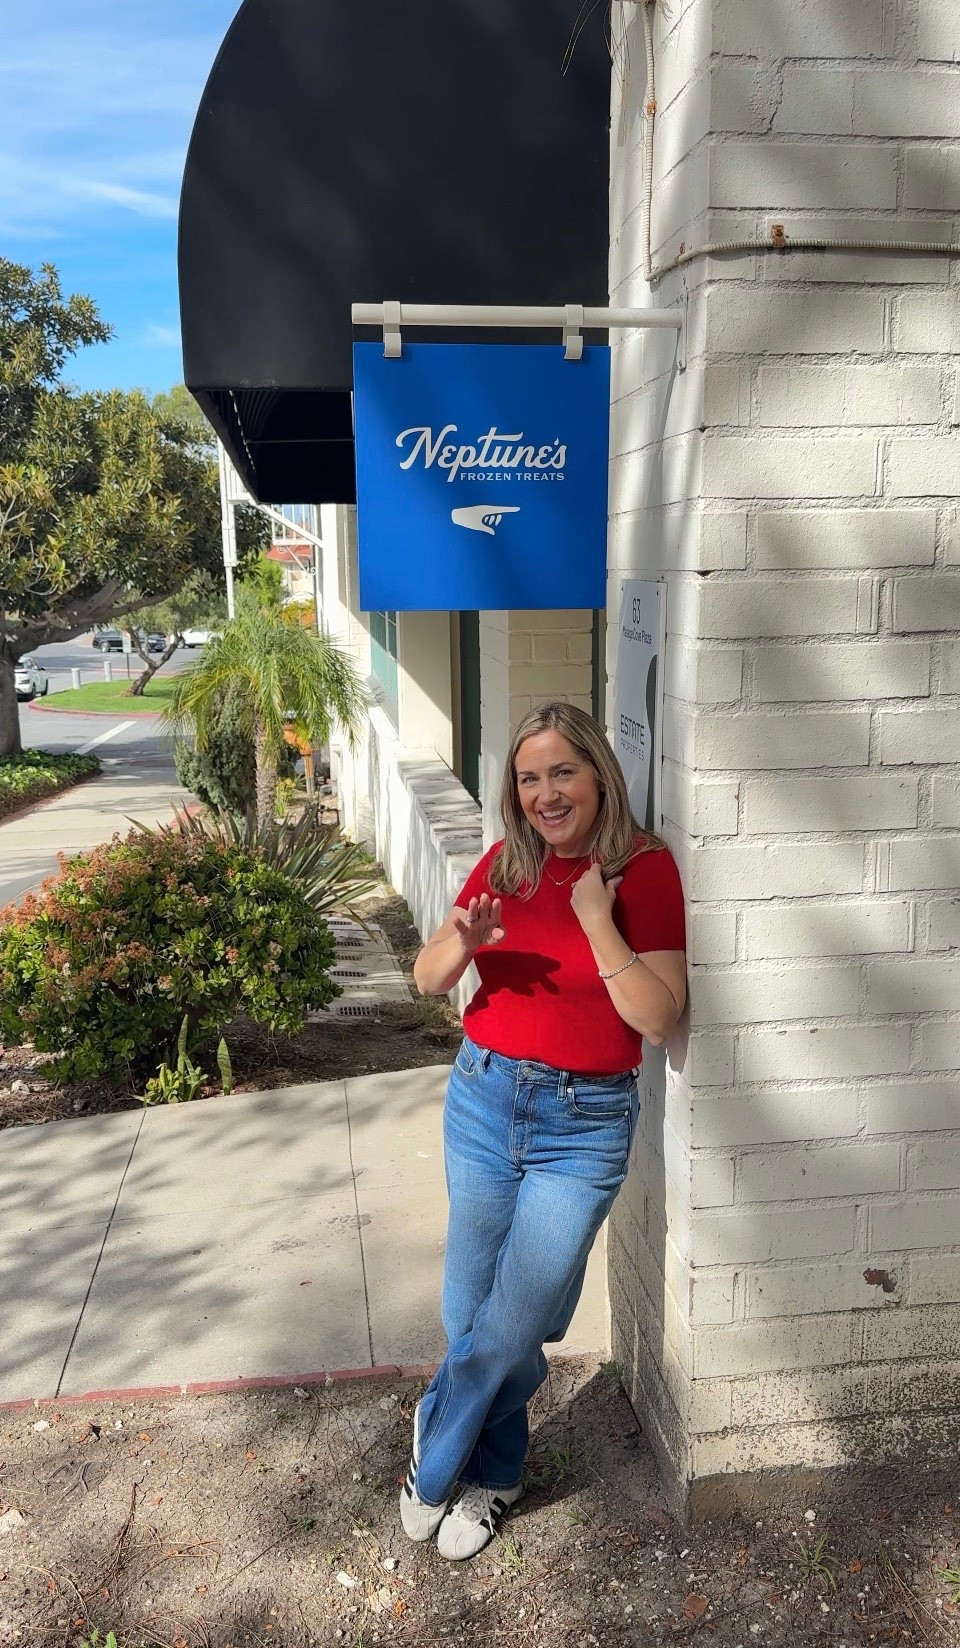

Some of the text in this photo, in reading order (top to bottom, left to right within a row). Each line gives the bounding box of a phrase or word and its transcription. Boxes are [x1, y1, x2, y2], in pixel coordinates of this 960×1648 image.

[395, 424, 568, 483] Neptune's
[460, 472, 565, 481] FROZEN TREATS
[632, 598, 640, 624] 63
[642, 630, 651, 644] Plaza
[621, 714, 644, 746] ESTATE
